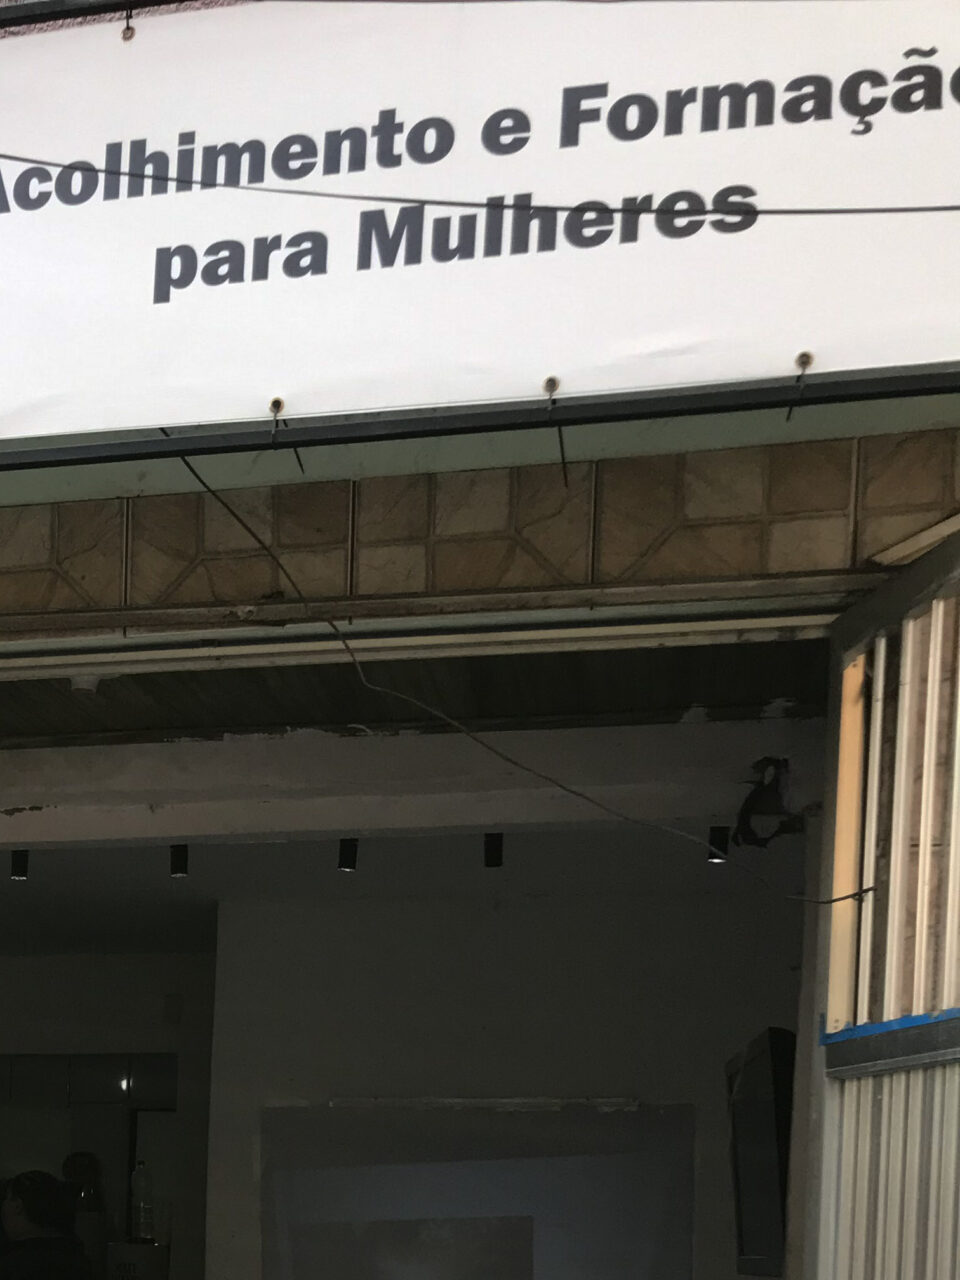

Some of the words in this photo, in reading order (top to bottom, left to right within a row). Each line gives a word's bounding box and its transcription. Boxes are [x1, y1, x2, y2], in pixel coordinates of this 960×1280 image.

[480, 107, 530, 156] e
[559, 46, 960, 149] Formaçã
[152, 226, 328, 305] para
[356, 184, 760, 271] Mulheres
